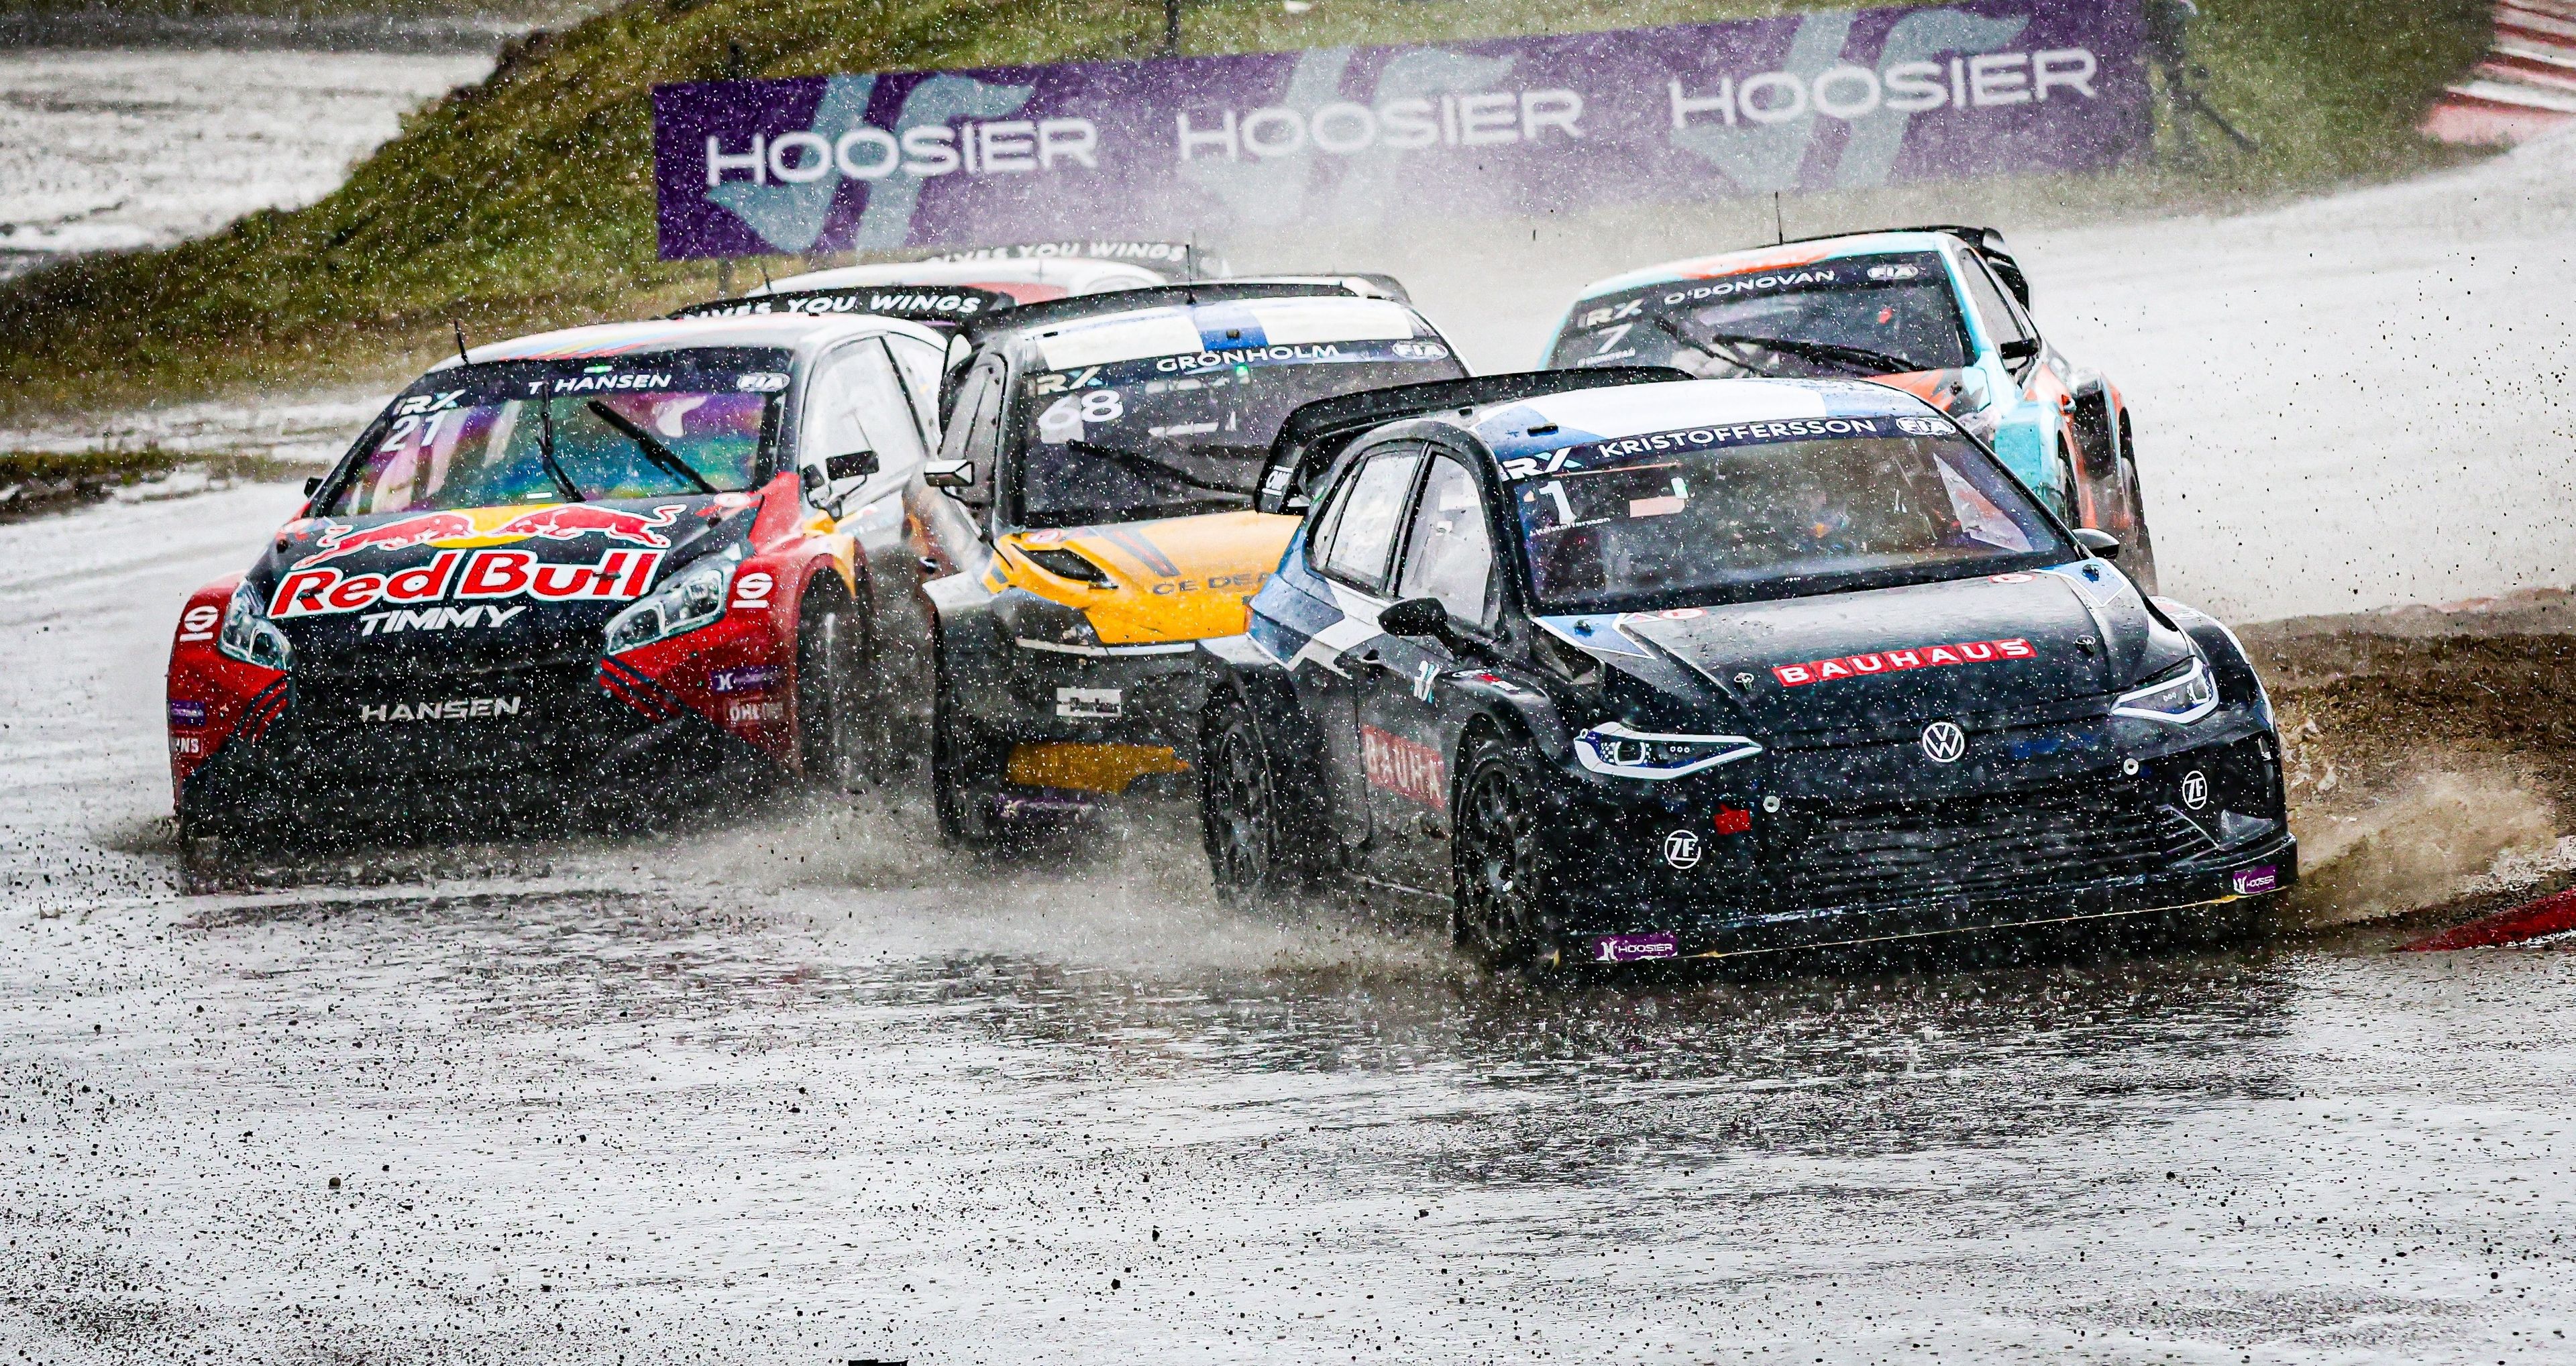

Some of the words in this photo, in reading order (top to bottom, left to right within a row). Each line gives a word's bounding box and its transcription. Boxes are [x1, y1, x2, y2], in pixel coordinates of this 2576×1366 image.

[1668, 48, 2098, 129] HOOSIER
[1177, 89, 1586, 162] HOOSIER
[706, 118, 1098, 186] HOOSIER
[1017, 243, 1081, 258] YOU
[1090, 243, 1187, 262] WINGS
[788, 296, 857, 314] YOU
[871, 294, 982, 314] WINGS
[1664, 270, 1835, 305] O'DONOVAN
[1597, 323, 1634, 355] 7
[554, 374, 672, 394] HANSEN
[1039, 389, 1124, 429] 68
[1898, 418, 1952, 434] FIA
[380, 409, 447, 453] 21
[1598, 420, 1878, 458] KRISTOFFERSSON
[1539, 480, 1576, 525] 1
[268, 551, 458, 618] Red
[460, 551, 662, 599] Bull
[360, 605, 526, 636] TIMMY
[1779, 639, 2031, 683] BAUHAUS
[361, 695, 521, 722] HANSEN
[1666, 834, 1699, 864] ZF
[1618, 944, 1673, 953] HOOSIER
